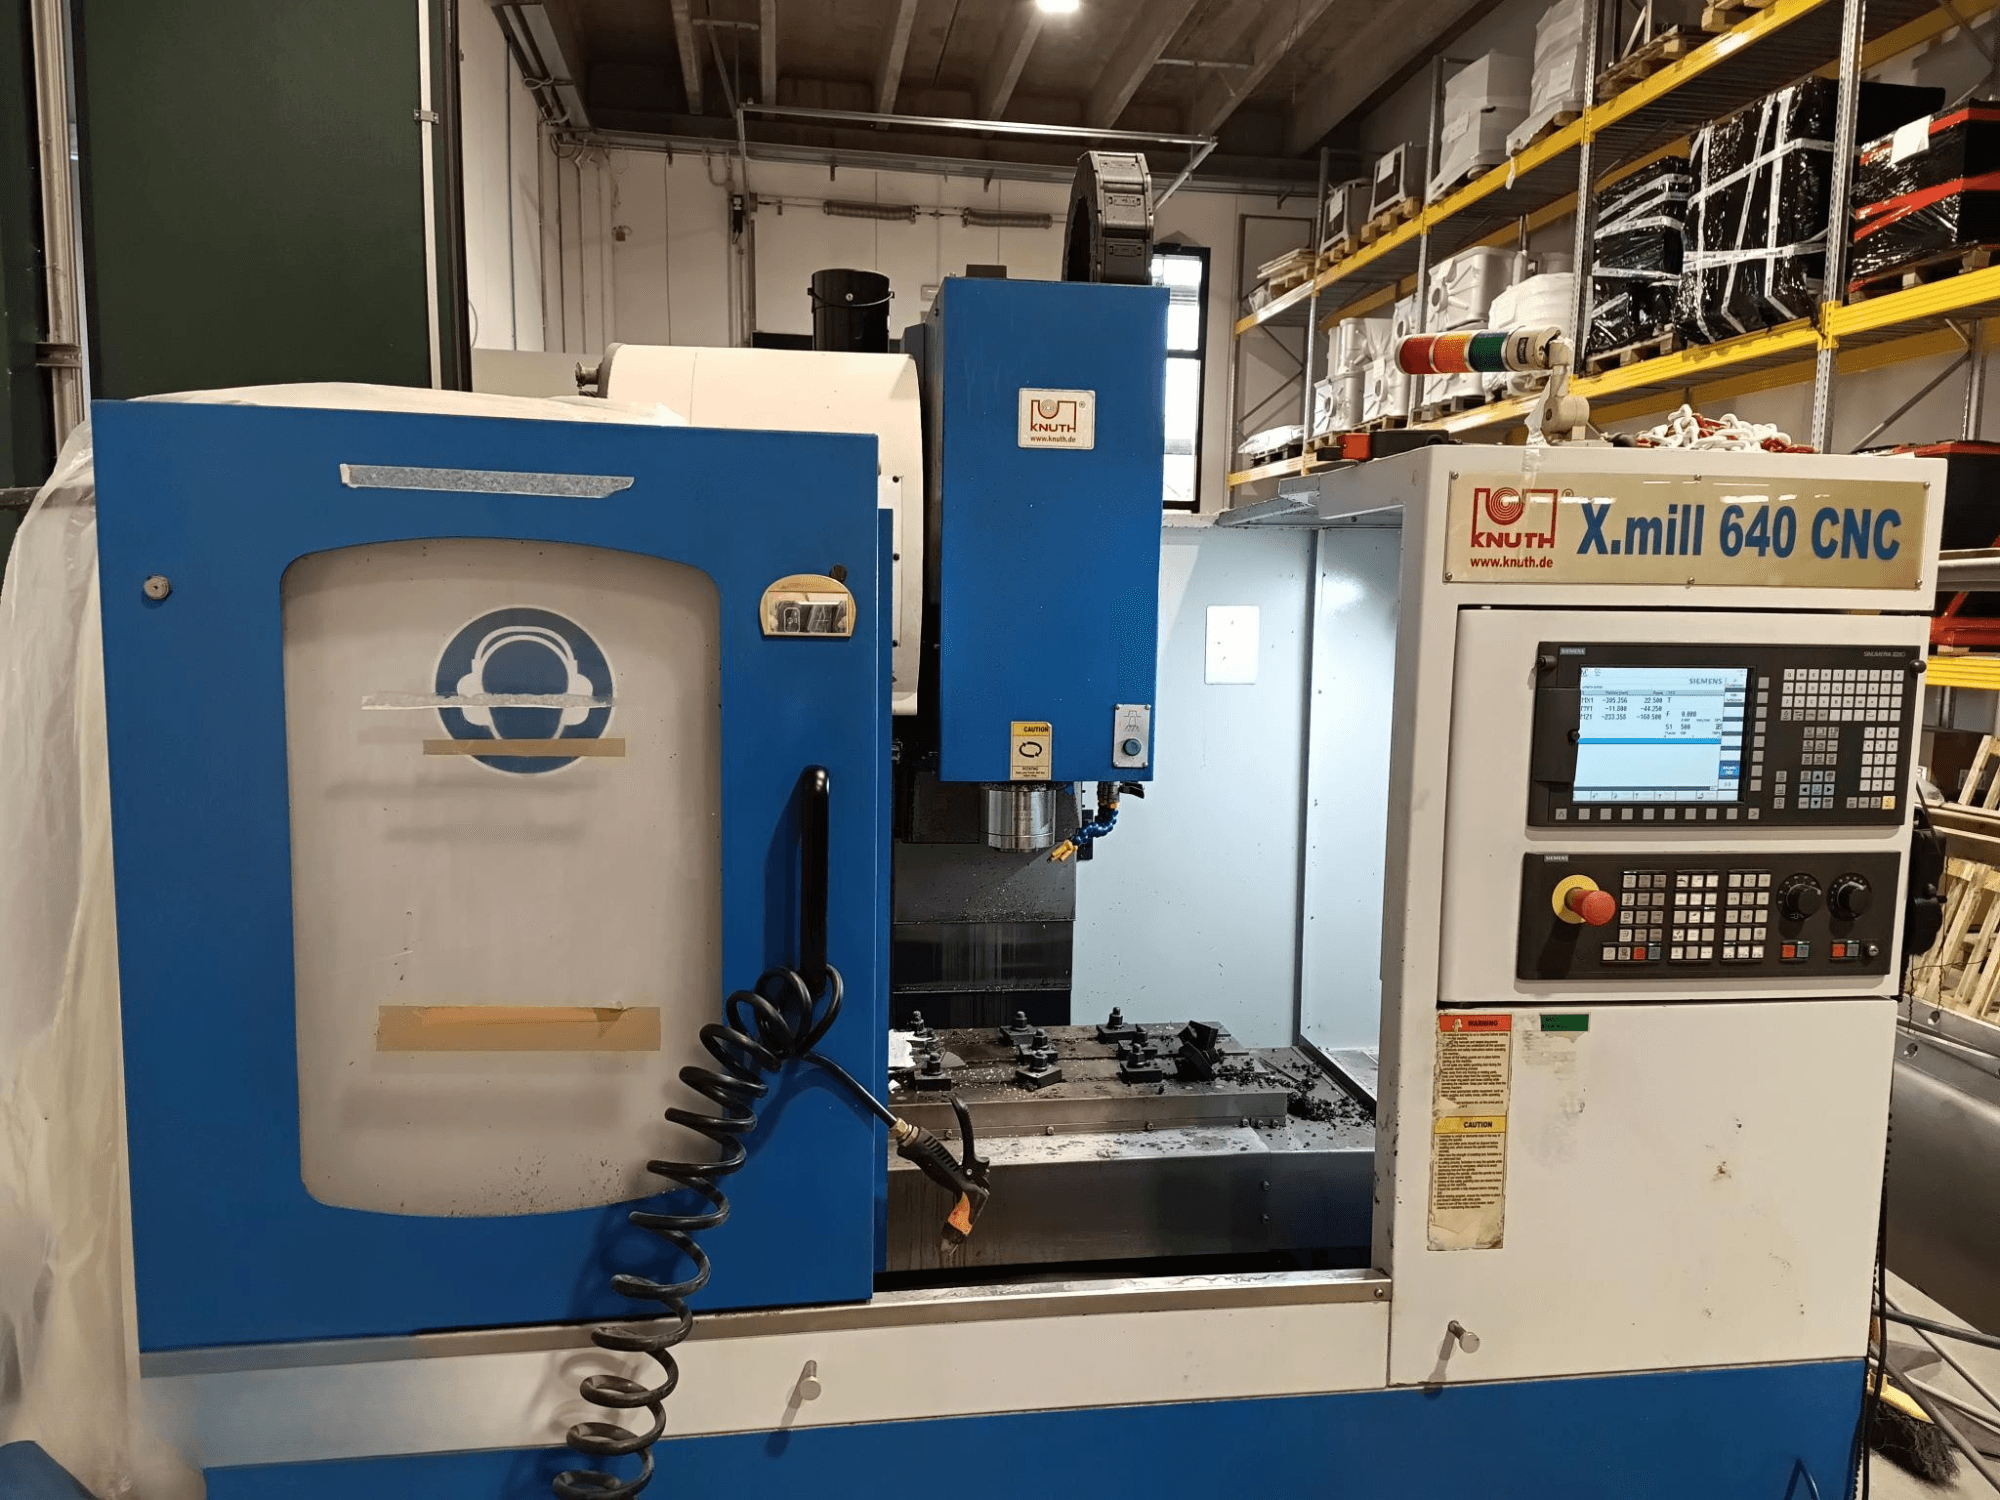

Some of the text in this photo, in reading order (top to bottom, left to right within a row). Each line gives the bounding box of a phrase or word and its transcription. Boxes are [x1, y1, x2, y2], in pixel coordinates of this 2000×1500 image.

[1030, 423, 1076, 433] KNUTH
[1030, 435, 1076, 443] www.knuth.de
[1577, 502, 1902, 560] X.mill 640 CNC
[1471, 532, 1555, 548] KNUTH
[1470, 556, 1553, 568] www.knuth.de
